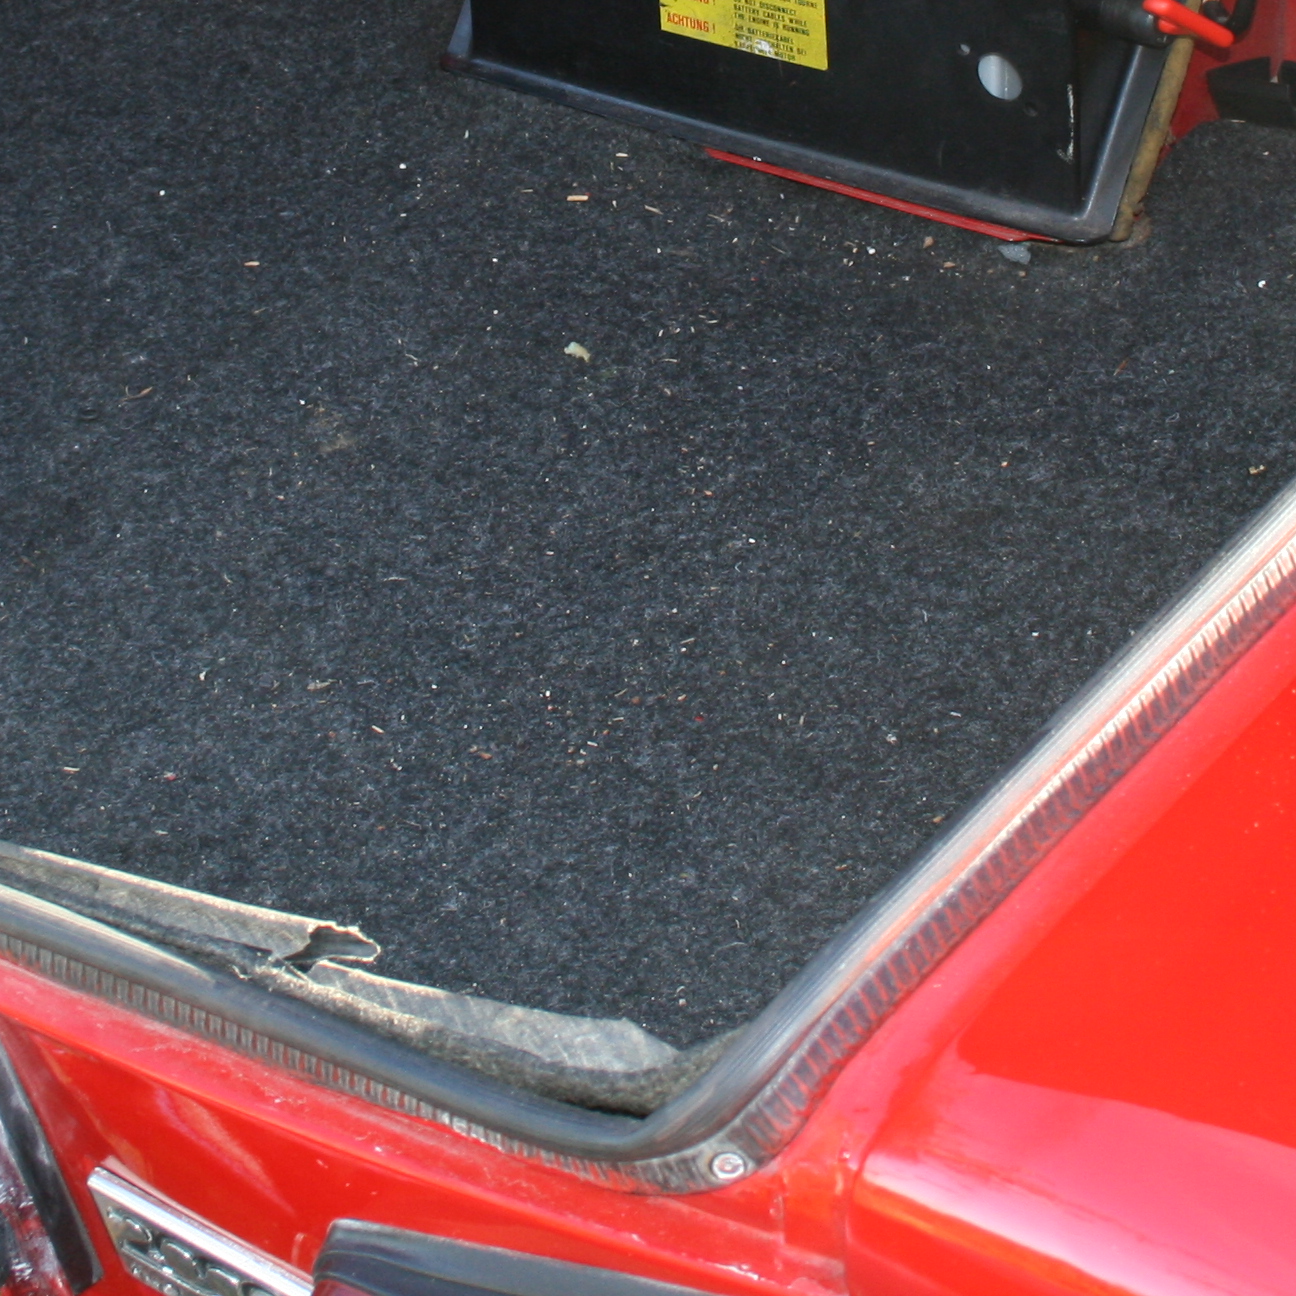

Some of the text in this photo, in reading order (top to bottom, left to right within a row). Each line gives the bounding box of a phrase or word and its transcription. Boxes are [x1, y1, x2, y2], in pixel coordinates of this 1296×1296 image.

[733, 3, 807, 27] BATTERY CABLES WHILE
[759, 0, 796, 16] DISCONNECT
[667, 12, 709, 33] ACHTUNG
[748, 14, 769, 27] ENGINE
[782, 22, 810, 36] RUNNING
[107, 1206, 274, 1296] 200
